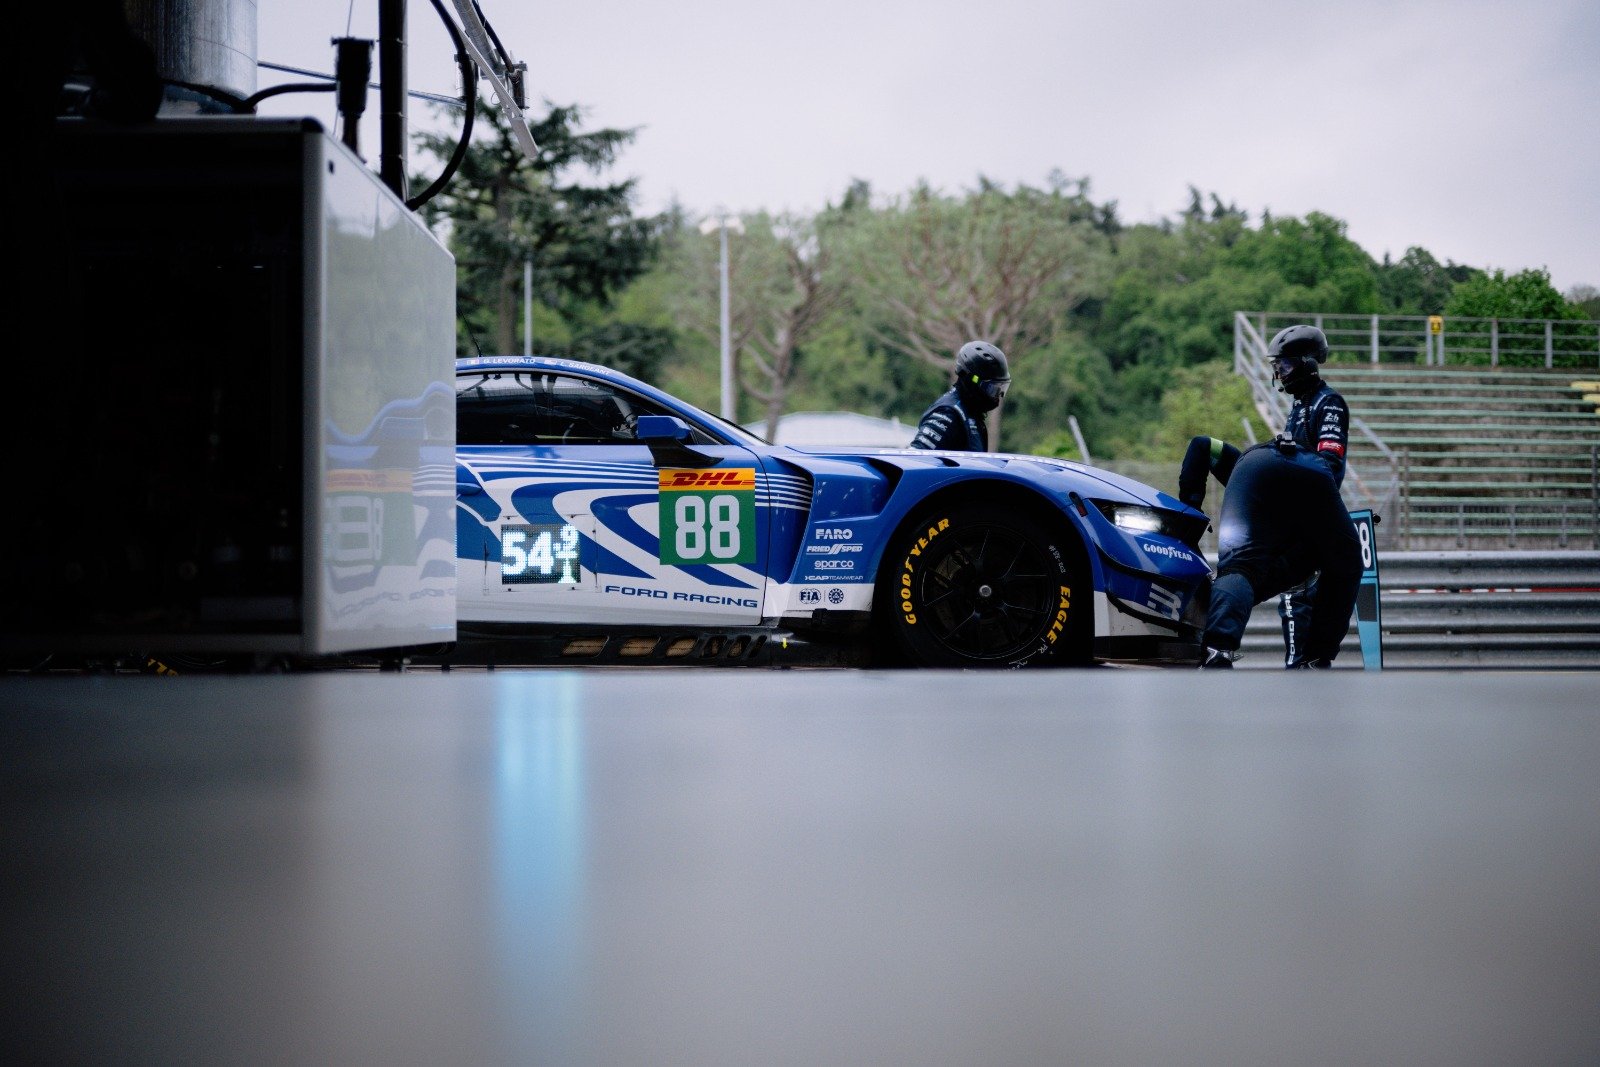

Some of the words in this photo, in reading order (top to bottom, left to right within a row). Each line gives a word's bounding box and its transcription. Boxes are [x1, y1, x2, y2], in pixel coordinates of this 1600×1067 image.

[569, 362, 610, 376] SARGEANT
[671, 472, 743, 486] DHL
[674, 494, 741, 560] 88
[815, 528, 853, 540] FARO
[1143, 543, 1193, 562] GOODYEAR
[814, 560, 854, 570] sparco
[605, 585, 668, 599] FORD
[673, 592, 758, 608] RACING
[1046, 585, 1071, 645] EAGLE
[1287, 620, 1295, 665] FORD
